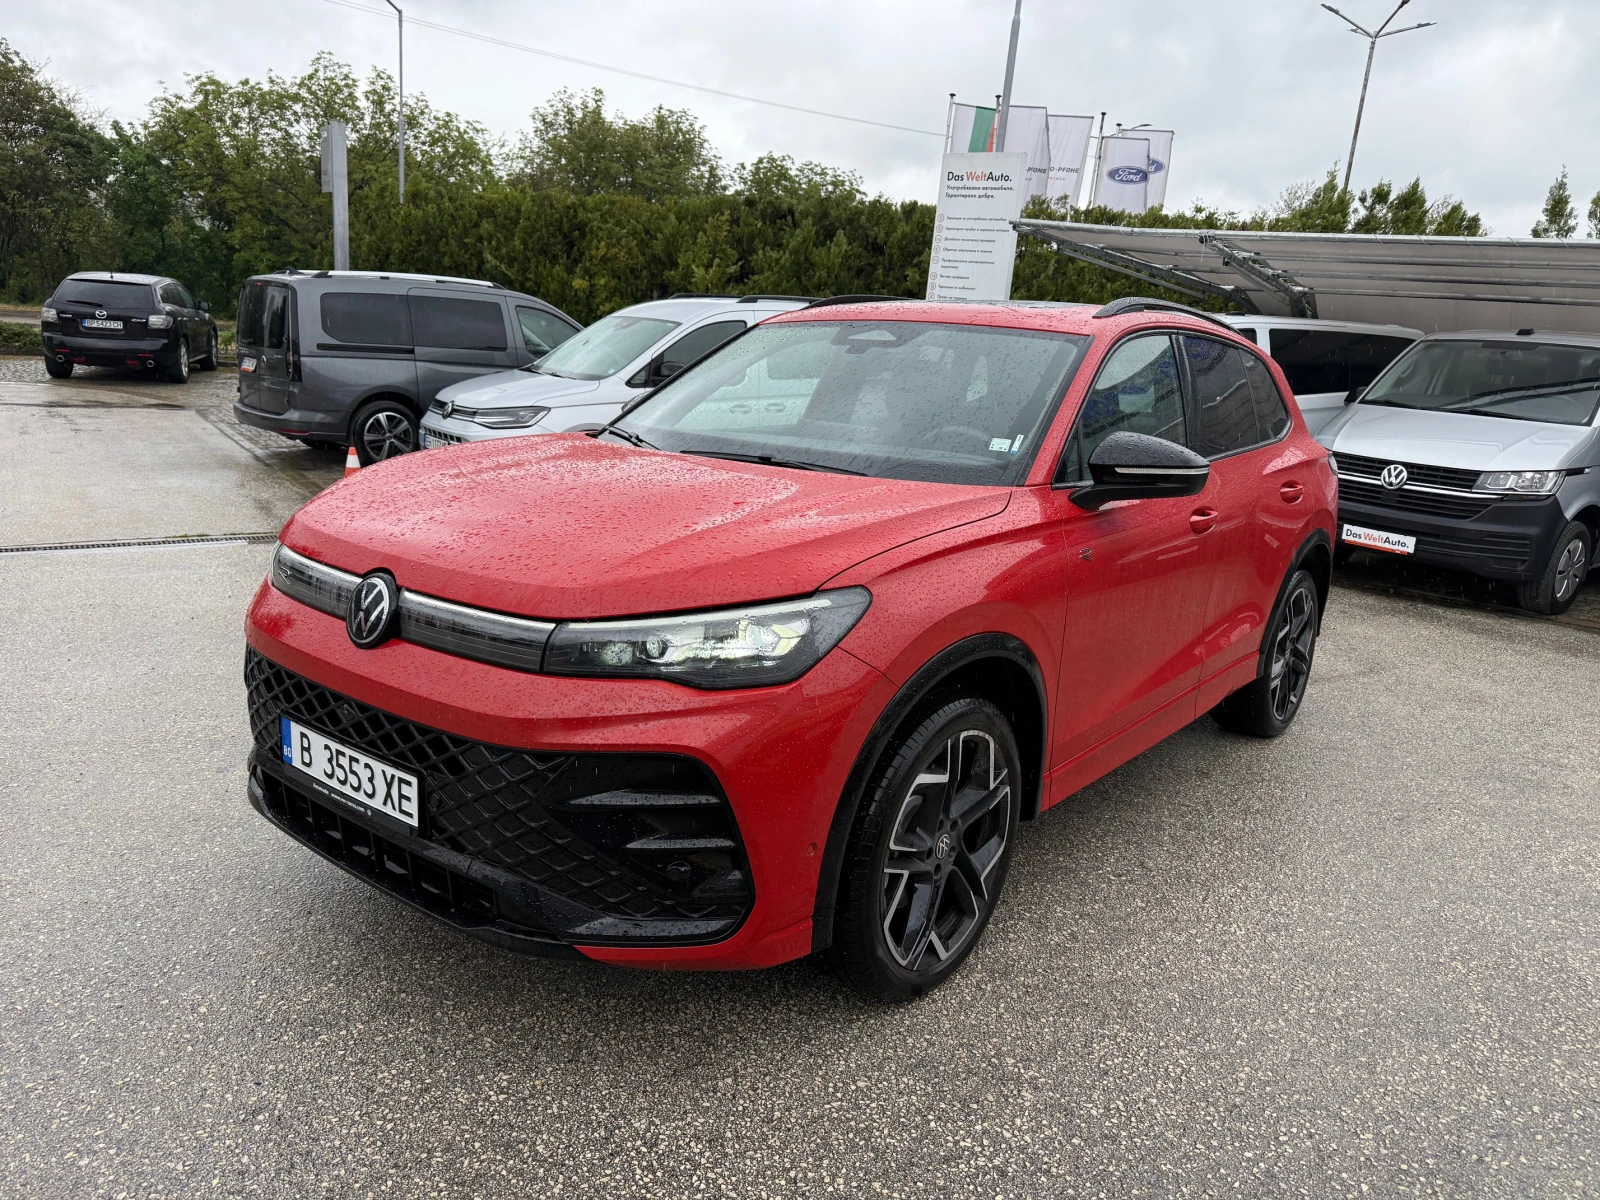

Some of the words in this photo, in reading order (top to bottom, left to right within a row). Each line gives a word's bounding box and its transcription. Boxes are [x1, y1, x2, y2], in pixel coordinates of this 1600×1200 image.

[948, 171, 964, 182] Das
[966, 171, 1012, 182] WeltAuto.
[1115, 168, 1143, 182] Ford
[1346, 529, 1362, 539] Das
[1364, 532, 1409, 548] WeltAuto.
[284, 745, 292, 757] BG
[300, 730, 312, 768] B
[324, 744, 376, 800] 3553
[381, 769, 414, 819] XE
